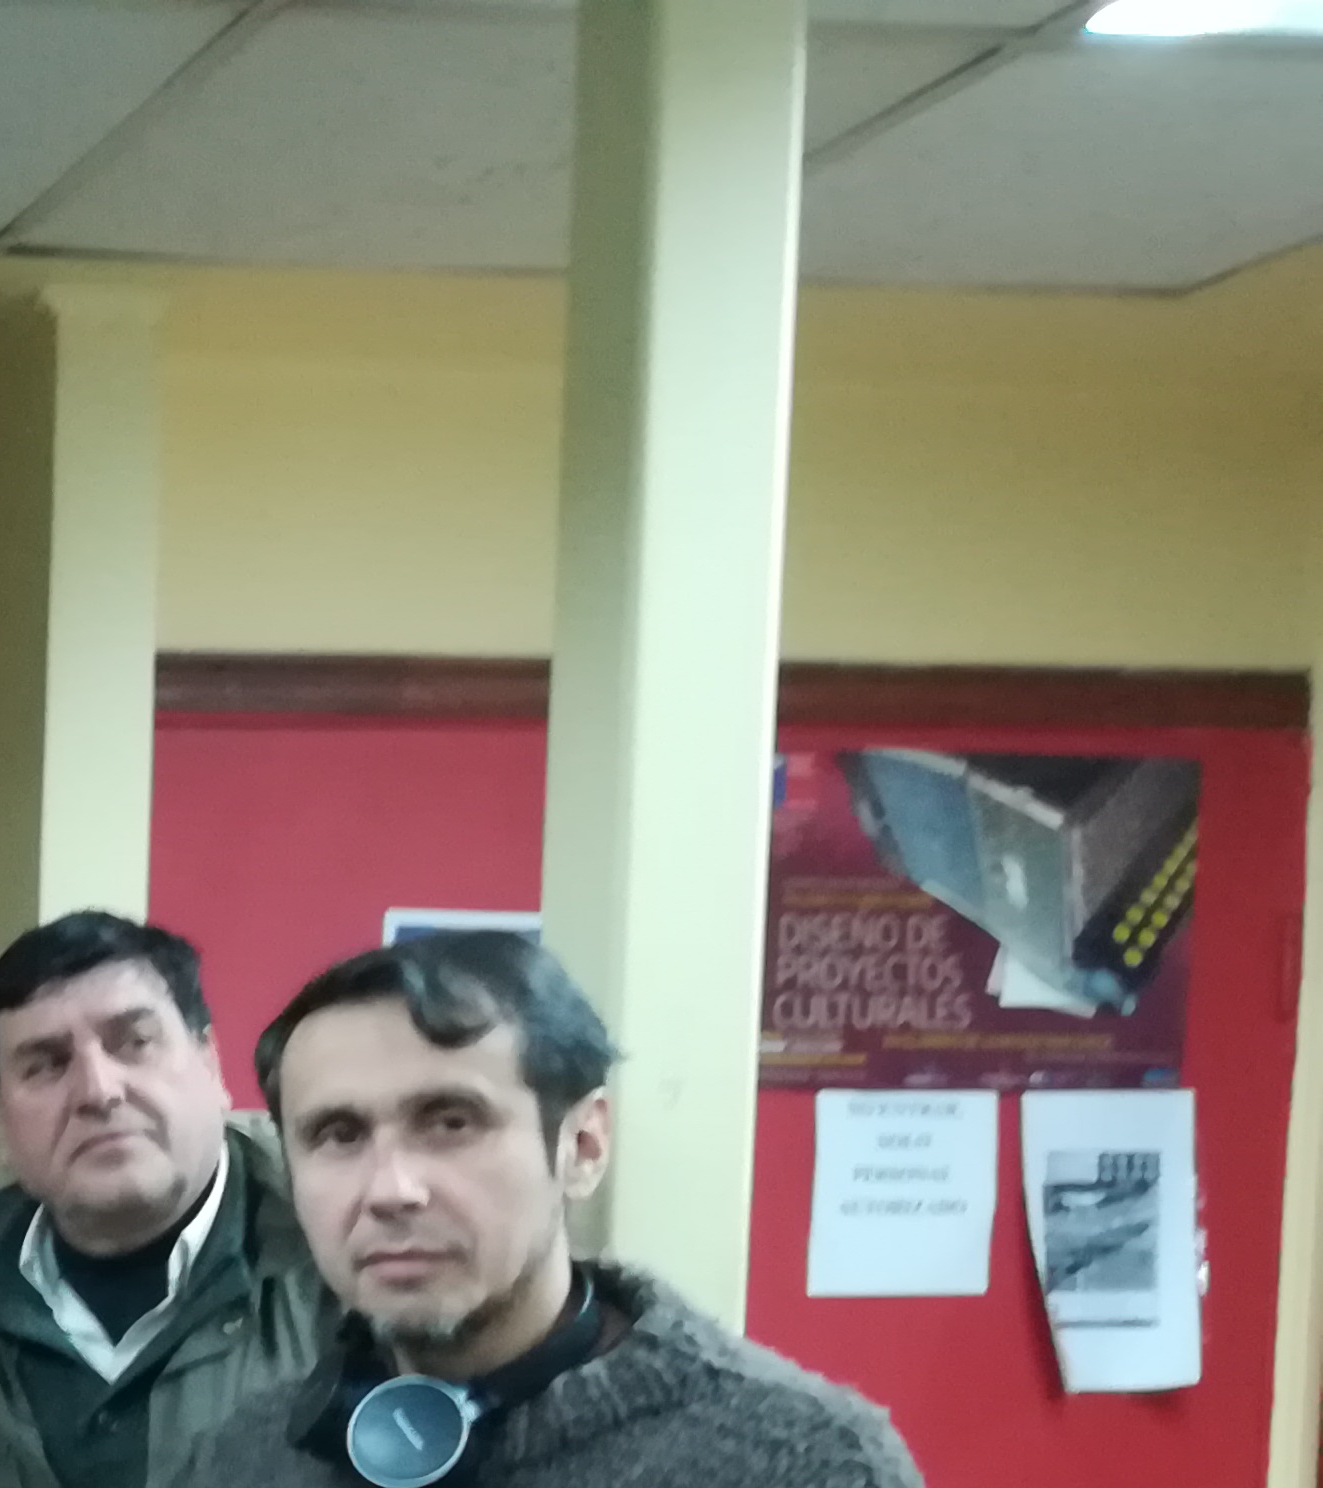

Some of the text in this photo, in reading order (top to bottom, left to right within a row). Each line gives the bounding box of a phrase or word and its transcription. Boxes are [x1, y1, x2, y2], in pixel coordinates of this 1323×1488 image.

[908, 913, 949, 950] DE
[776, 953, 964, 990] PROYECTOS
[772, 992, 972, 1030] CULTURALES
